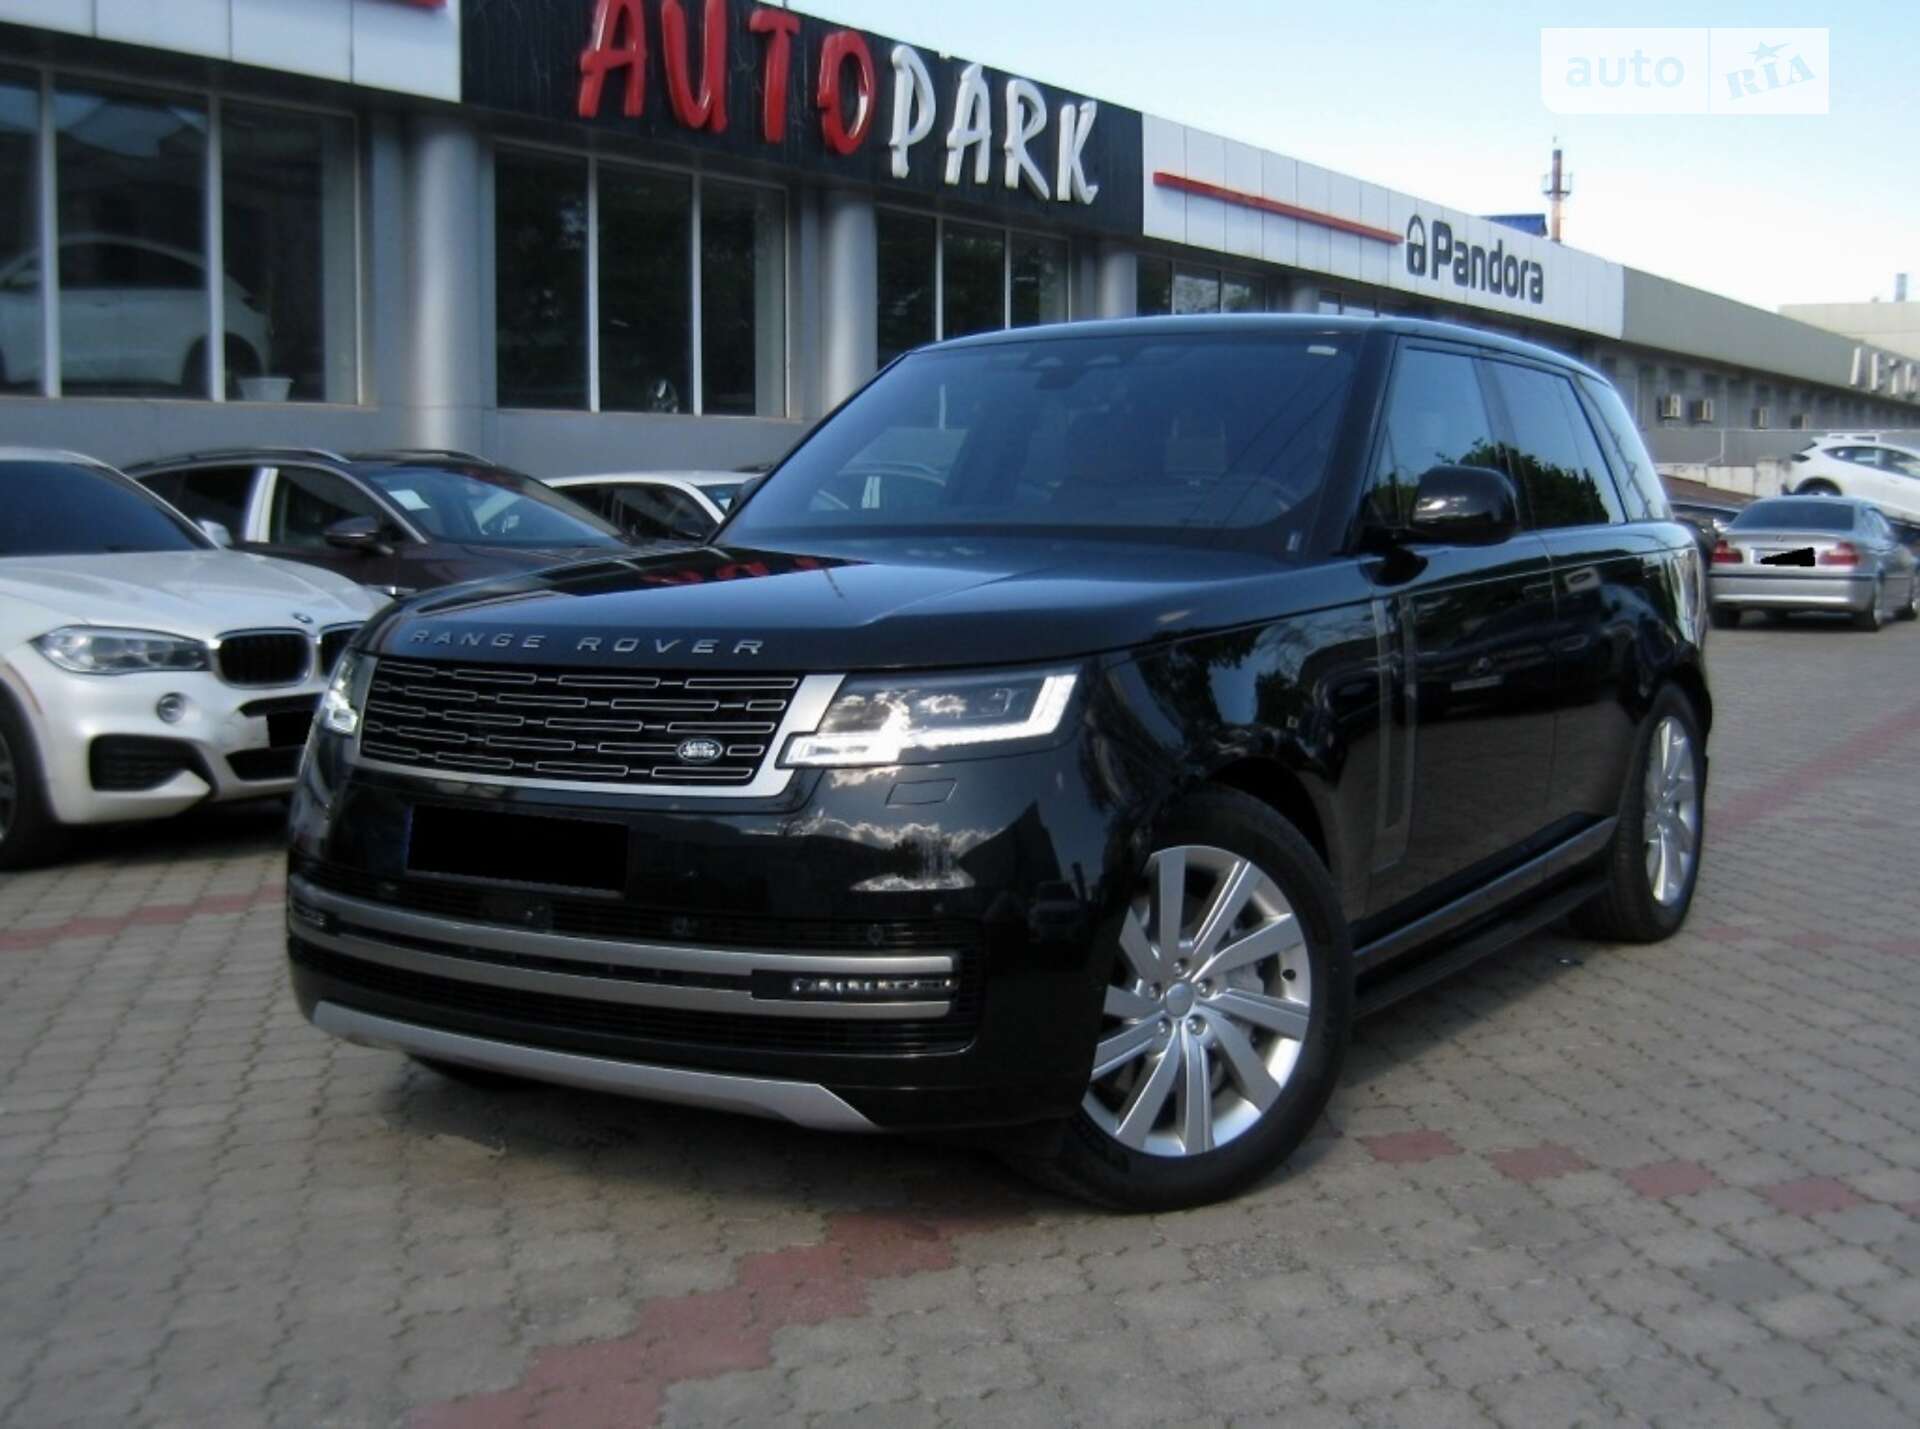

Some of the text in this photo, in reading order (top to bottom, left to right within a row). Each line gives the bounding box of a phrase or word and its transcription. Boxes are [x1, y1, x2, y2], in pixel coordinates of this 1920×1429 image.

[1431, 220, 1544, 305] Pandora
[409, 630, 764, 655] RANGE ROVER
